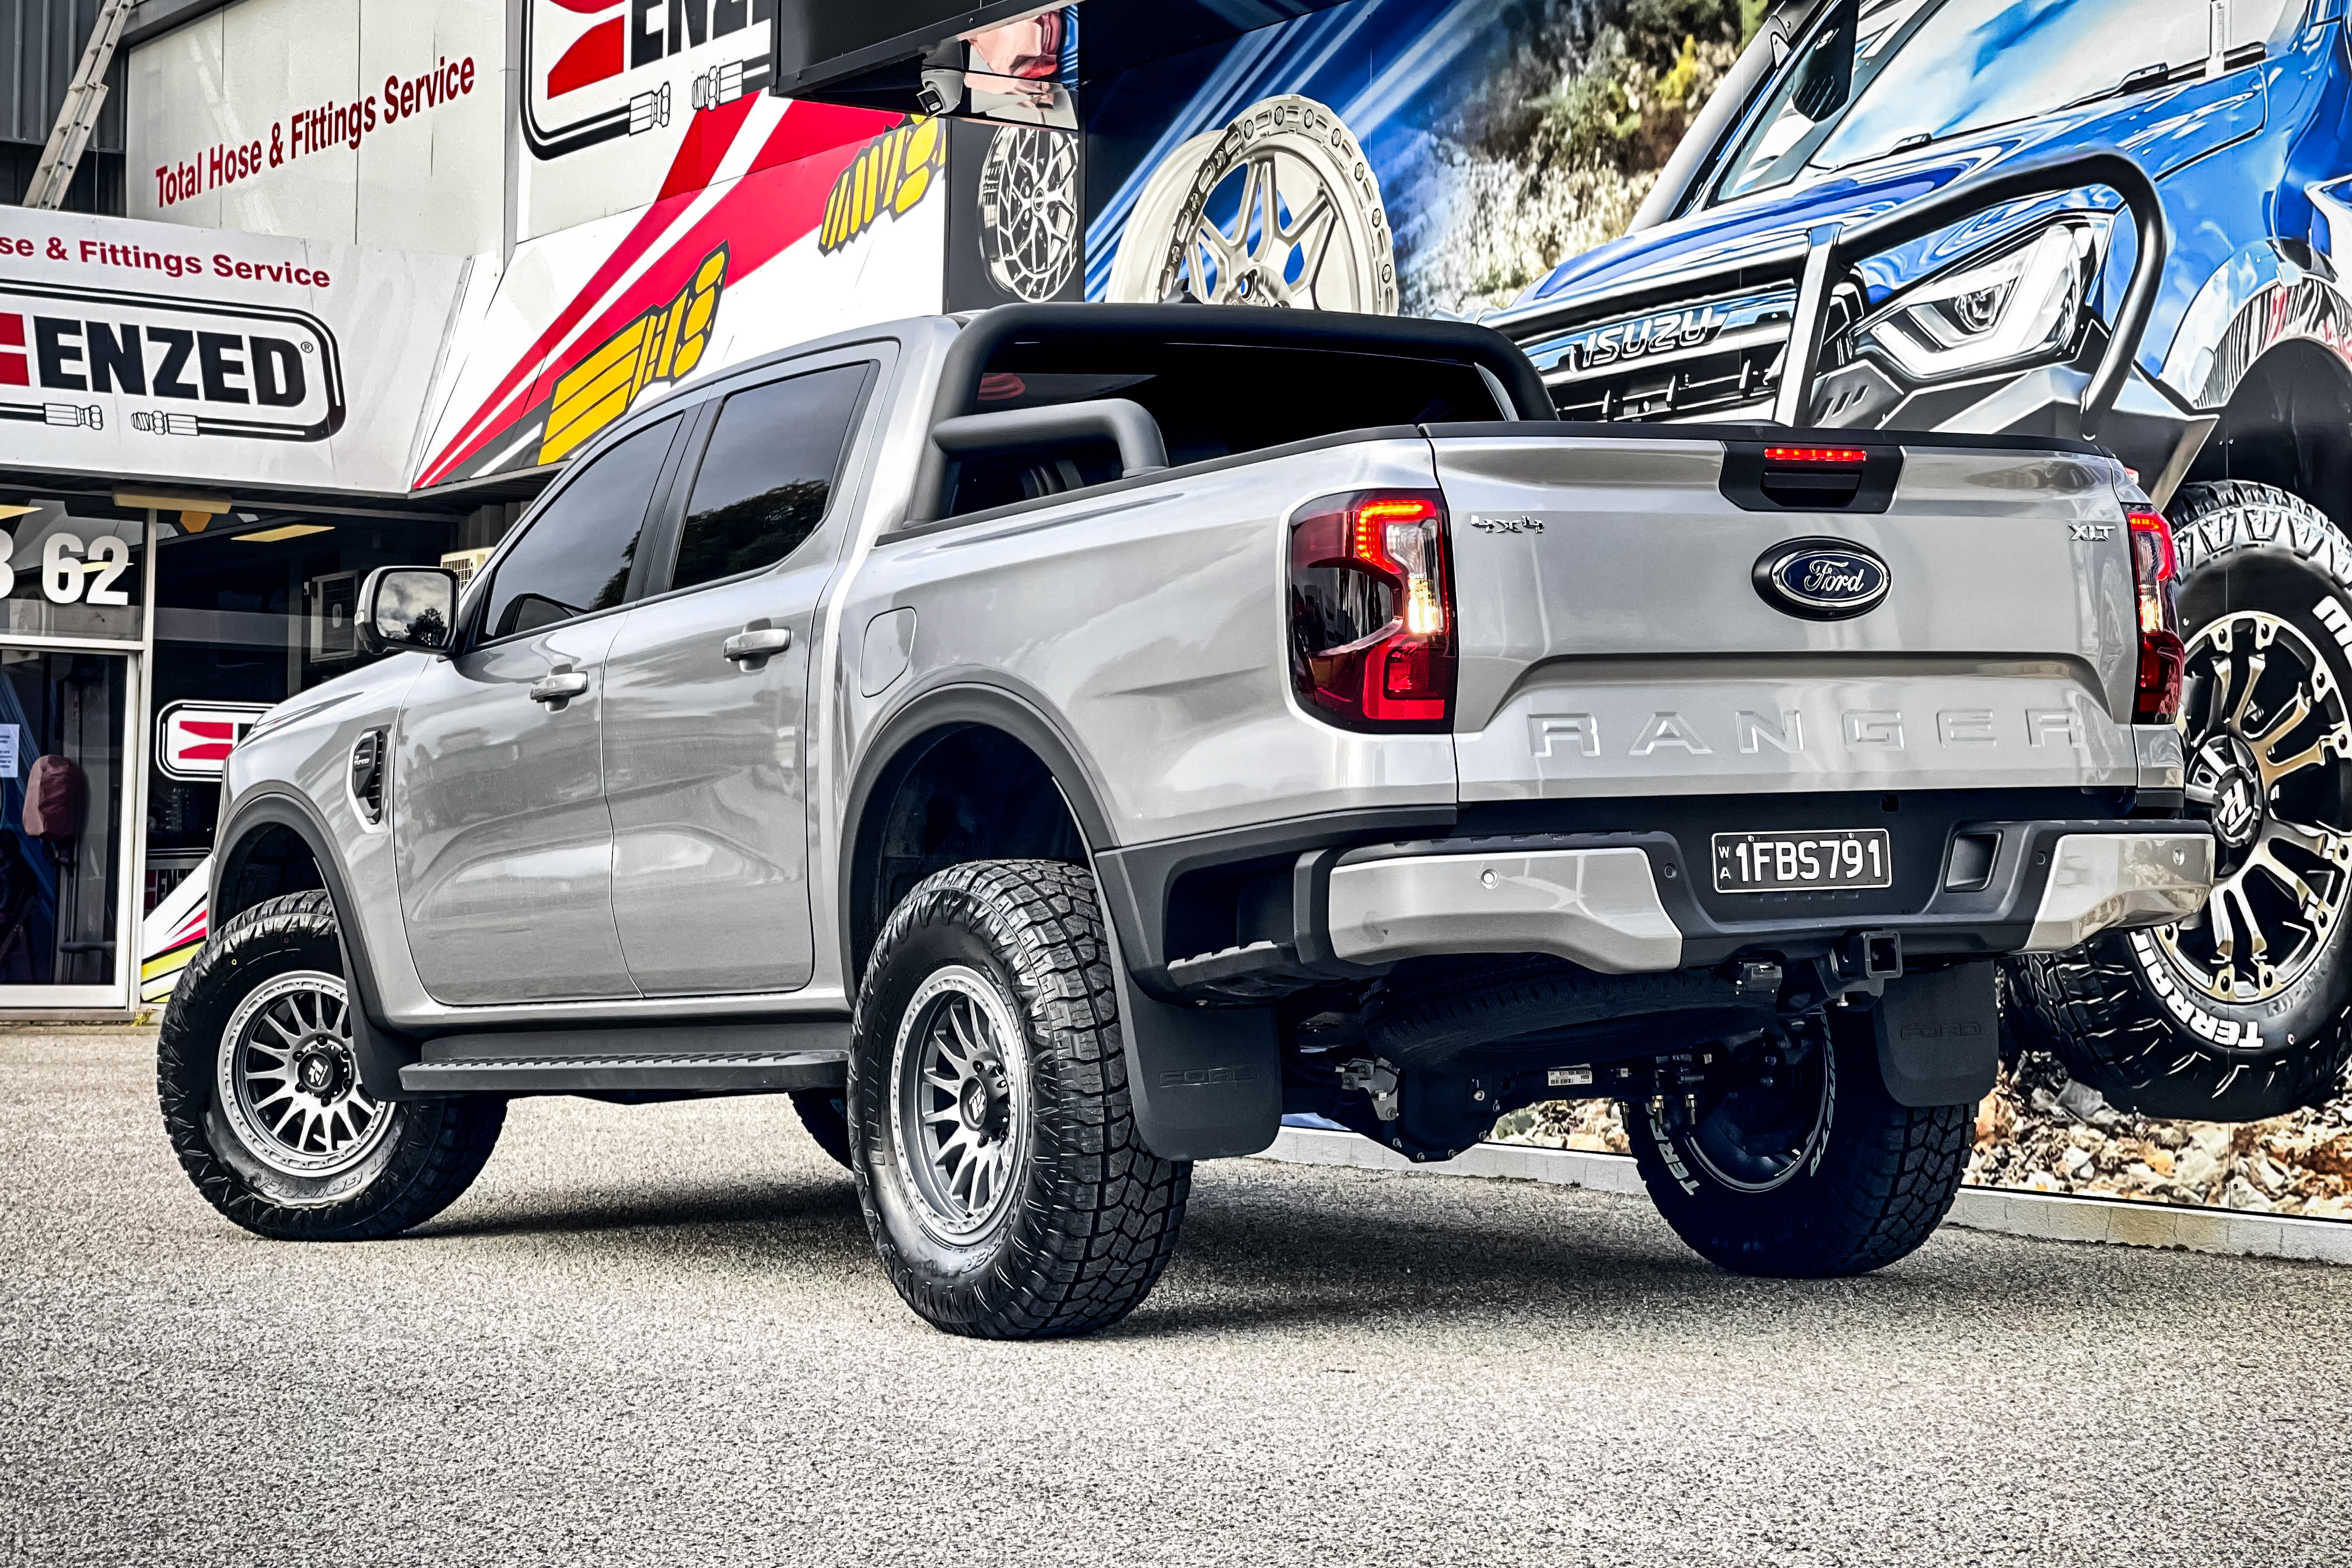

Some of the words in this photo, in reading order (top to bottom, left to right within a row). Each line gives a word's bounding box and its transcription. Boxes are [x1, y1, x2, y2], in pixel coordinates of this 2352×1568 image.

[156, 152, 202, 208] Total
[209, 140, 262, 190] Hose
[270, 123, 284, 168] &
[291, 96, 376, 160] Fittings
[384, 57, 475, 124] Service
[46, 237, 69, 260] &
[79, 240, 202, 278] Fittings
[213, 254, 330, 288] Service
[1582, 306, 1713, 368] ISUZU
[2068, 524, 2116, 541] XLT
[42, 533, 130, 606] 62
[1804, 559, 1864, 592] Ford
[1527, 708, 2085, 757] RANGER
[1735, 839, 1881, 881] 1FBS791
